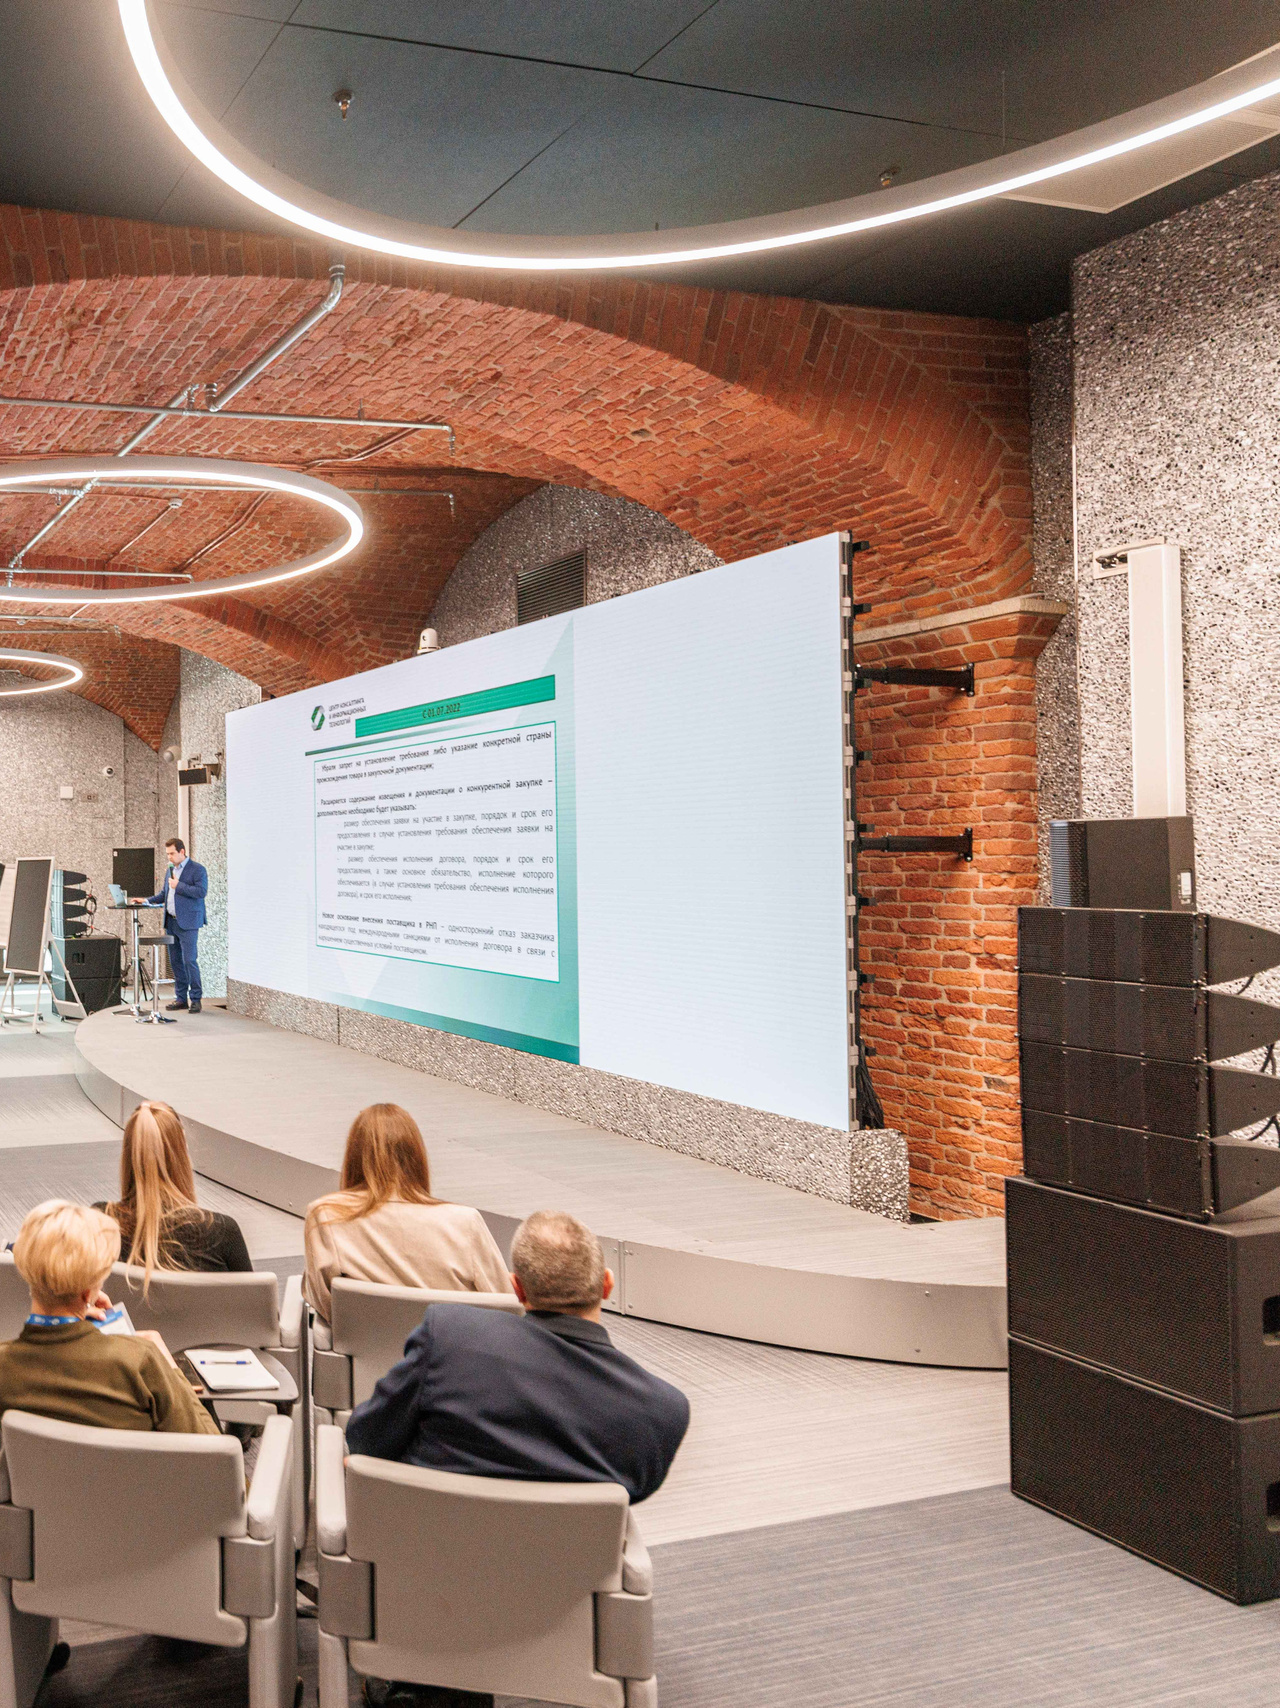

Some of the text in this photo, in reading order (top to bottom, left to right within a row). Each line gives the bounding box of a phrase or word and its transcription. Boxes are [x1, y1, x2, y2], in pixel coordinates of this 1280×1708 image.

[427, 700, 461, 719] 01.07.2022
[432, 744, 447, 755] либо
[450, 741, 478, 755] указание
[482, 733, 521, 750] конкретной
[525, 729, 552, 744] страны
[466, 779, 511, 795] конкурентной
[514, 777, 543, 790] закупке
[480, 810, 508, 822] порядок
[520, 808, 537, 820] срок
[540, 808, 553, 817] его
[435, 825, 468, 838] требования
[471, 824, 512, 835] обеспечения
[516, 824, 540, 833] заявки
[472, 855, 499, 865] порядок
[517, 855, 534, 866] срок
[541, 855, 554, 864] его
[477, 869, 515, 878] исполнение
[522, 870, 554, 881] которого
[433, 880, 466, 893] требования
[468, 882, 509, 893] обеспечения
[512, 885, 554, 895] исполнения
[447, 922, 494, 938] односторонний
[497, 928, 516, 938] отказ
[520, 930, 555, 942] заказчика
